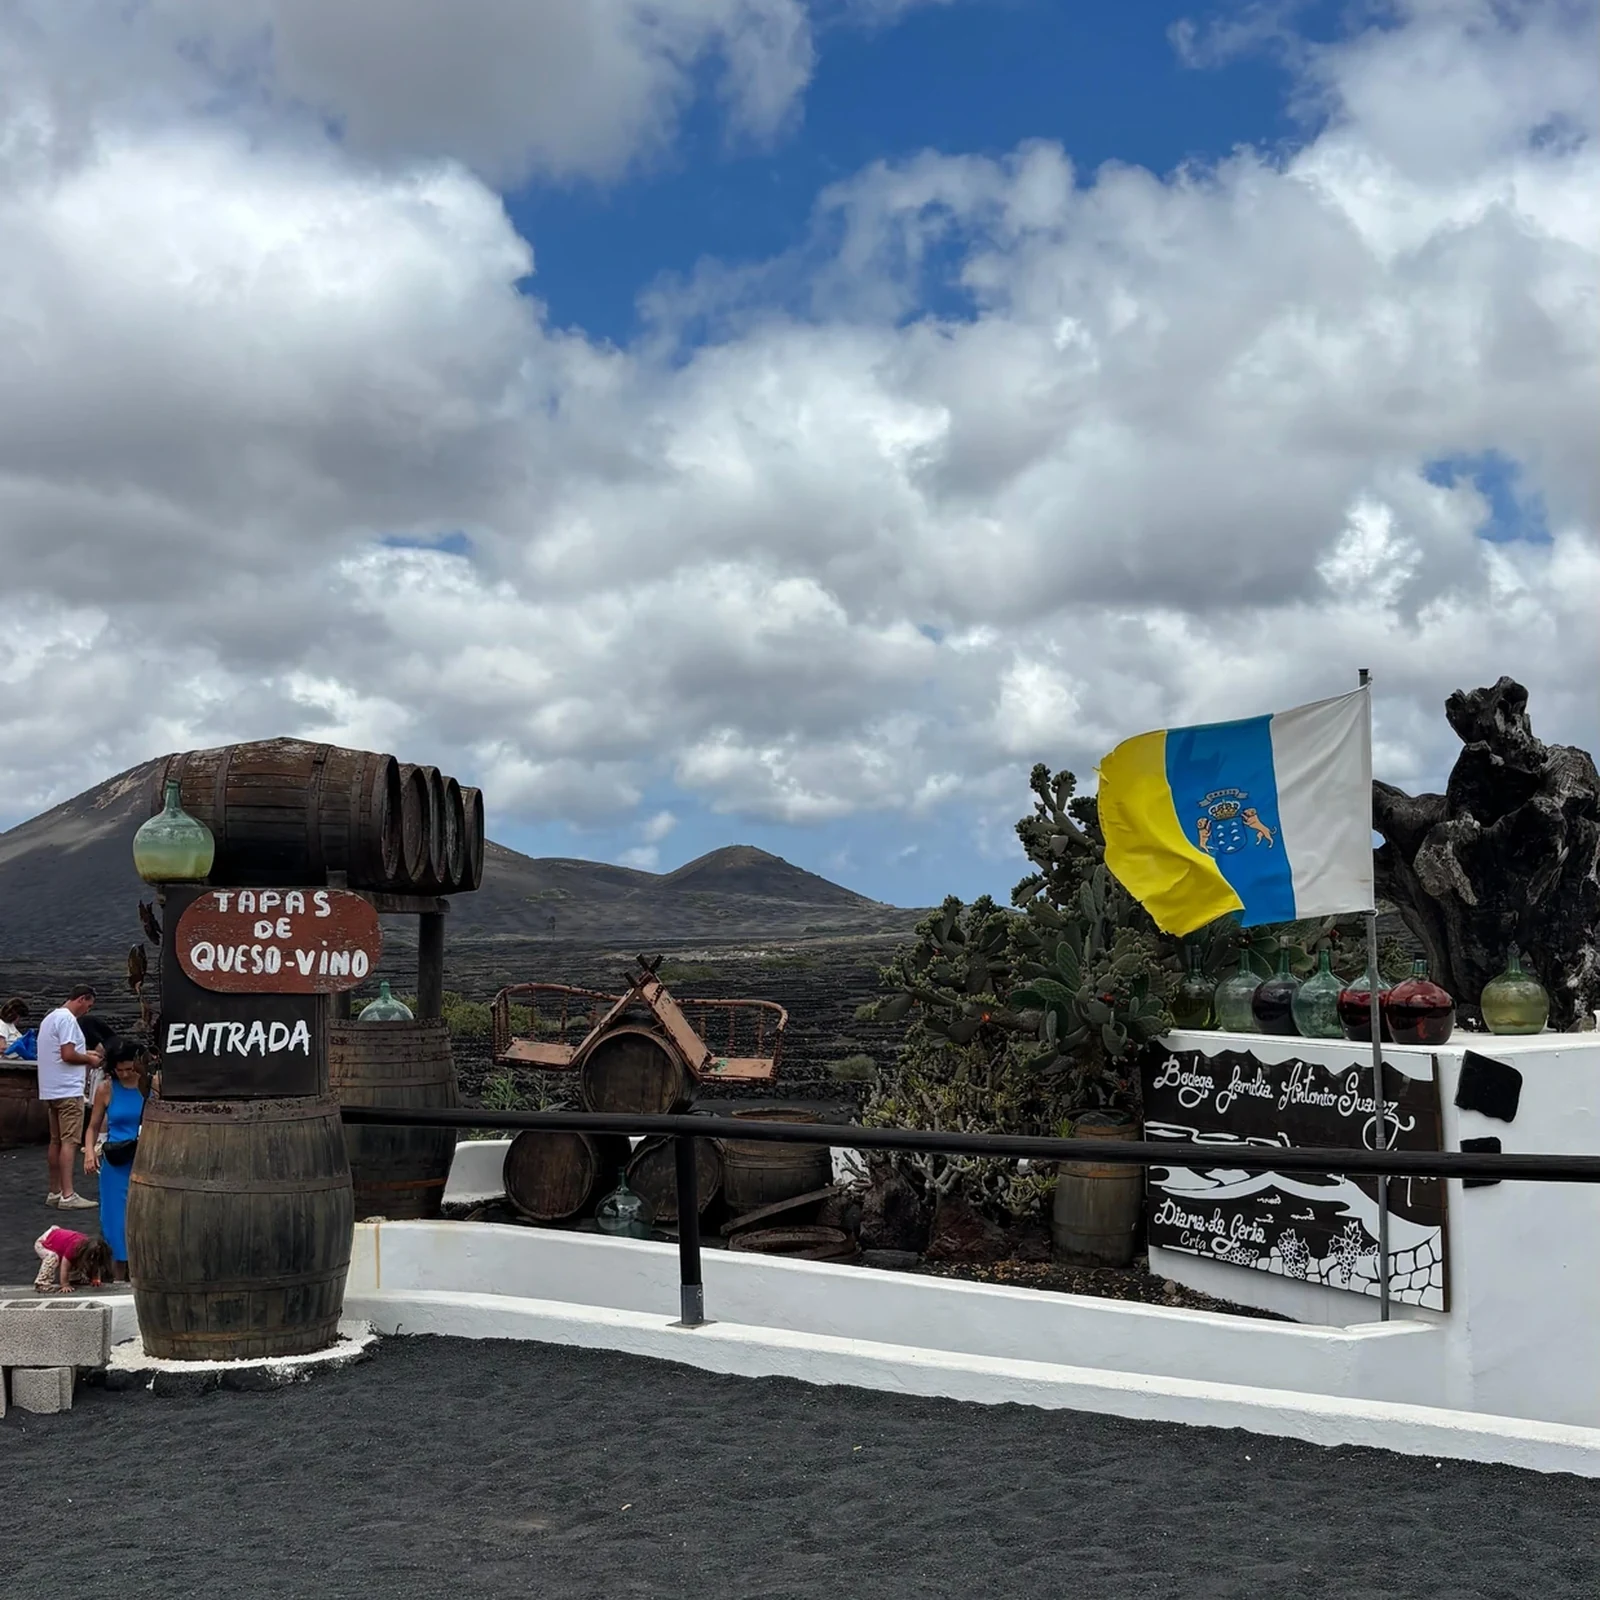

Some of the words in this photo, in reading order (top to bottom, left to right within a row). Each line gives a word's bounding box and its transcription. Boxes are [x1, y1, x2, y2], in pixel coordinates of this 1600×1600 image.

[213, 890, 332, 917] TAPAS
[254, 917, 293, 939] DE
[165, 1020, 312, 1057] ENTRADA
[1153, 1054, 1215, 1108] Bodega
[1277, 1061, 1338, 1110] Antonio
[1180, 1230, 1207, 1250] Crta
